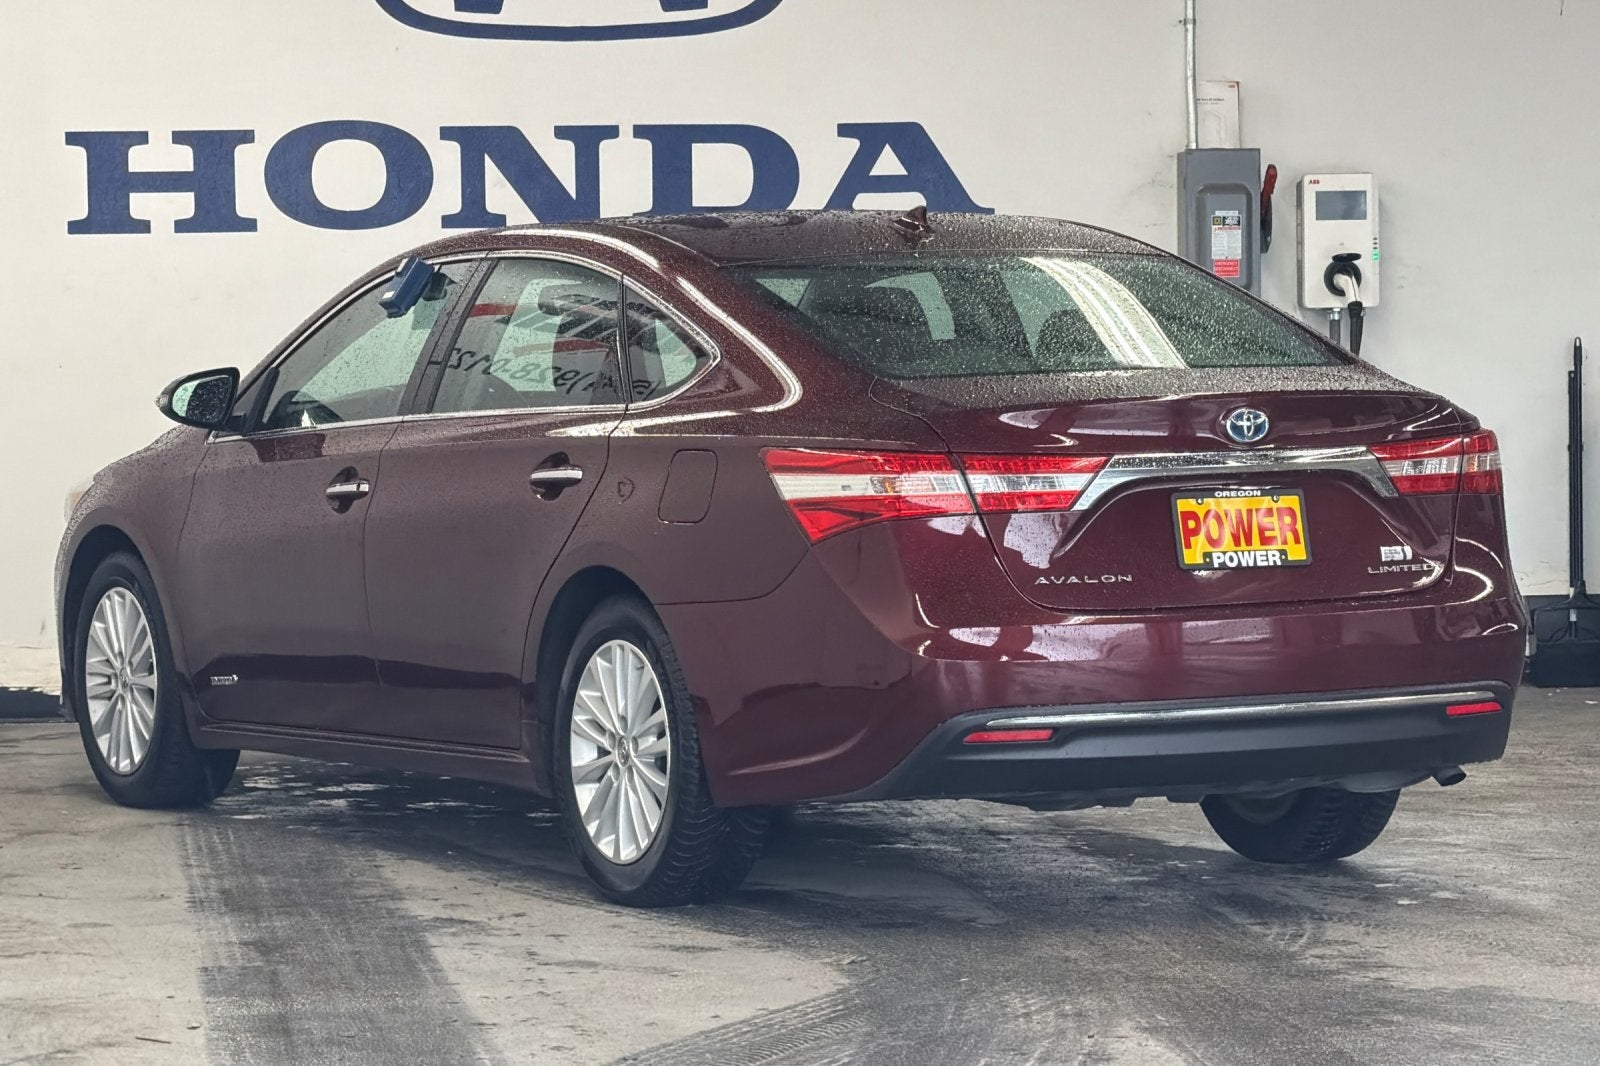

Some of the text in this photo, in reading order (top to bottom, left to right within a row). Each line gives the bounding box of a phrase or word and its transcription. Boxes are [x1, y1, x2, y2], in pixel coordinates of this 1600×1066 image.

[66, 119, 994, 235] HONDA
[1214, 490, 1261, 498] OREGON
[1180, 507, 1302, 550] POWER
[1212, 550, 1282, 568] POWER
[1367, 563, 1434, 574] LIMITED
[1034, 574, 1133, 585] AVALON
